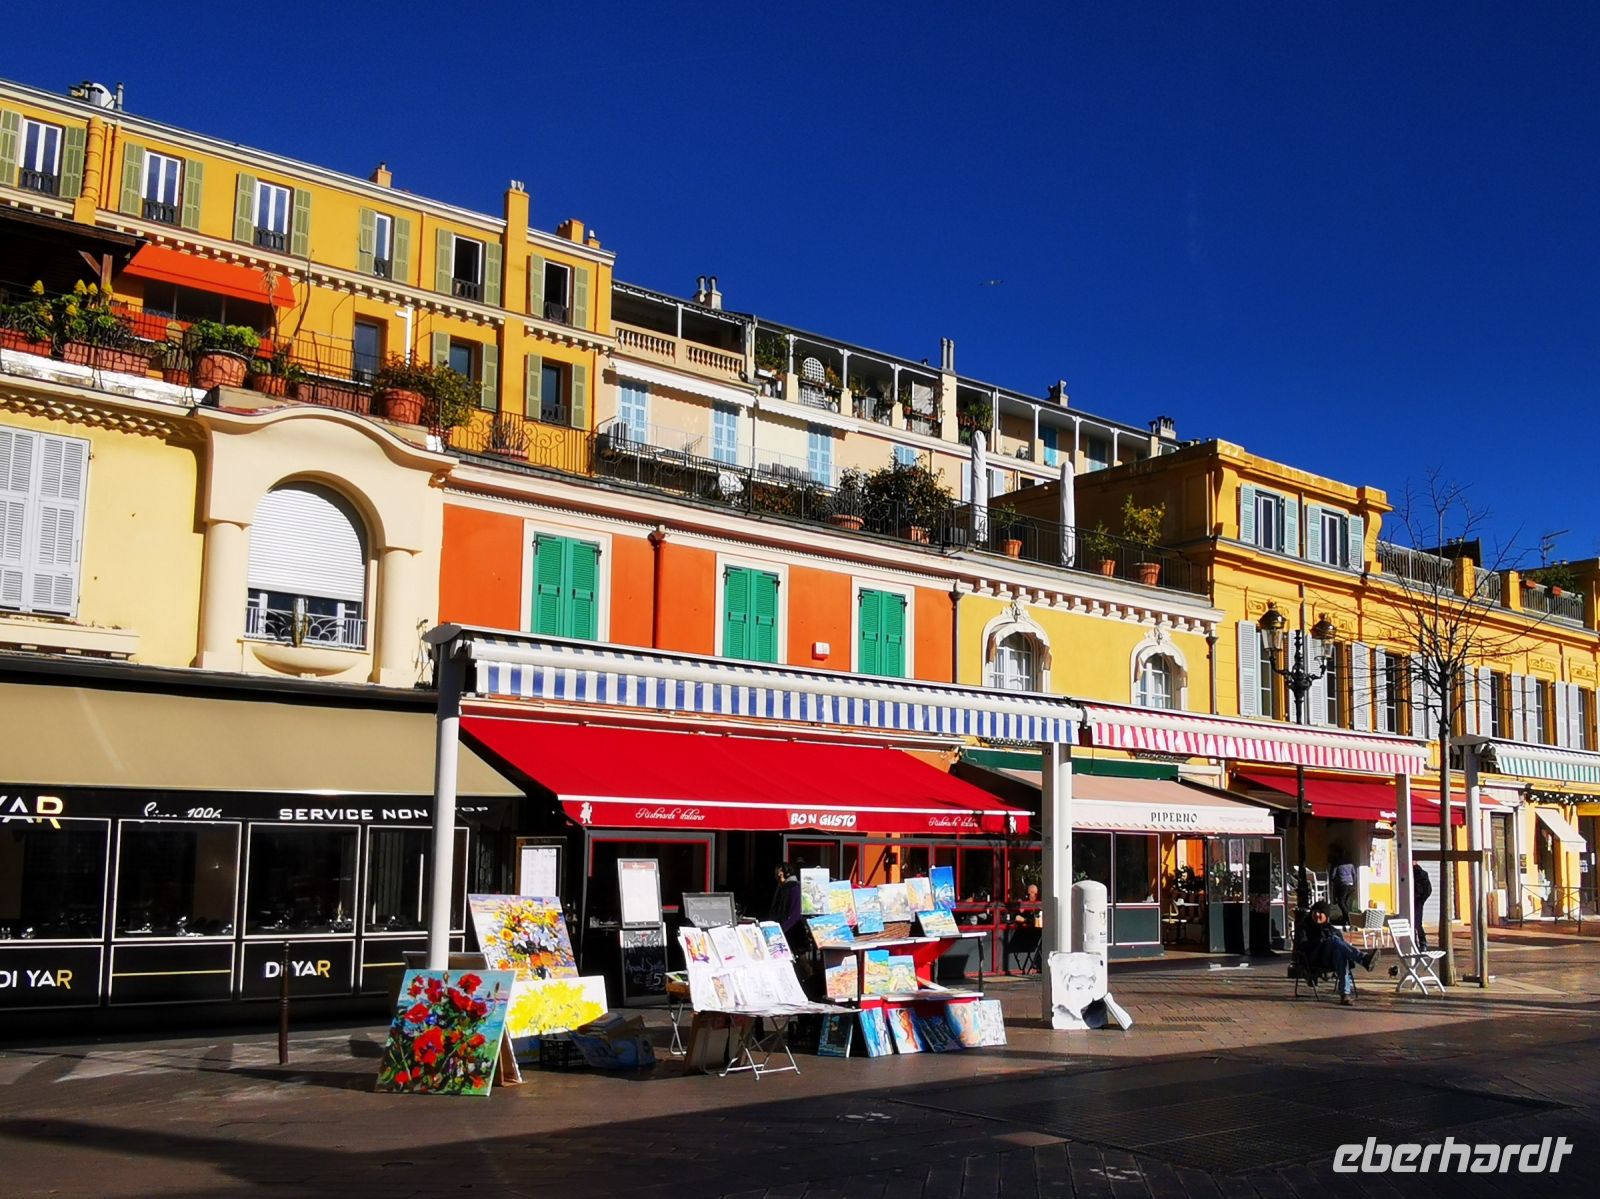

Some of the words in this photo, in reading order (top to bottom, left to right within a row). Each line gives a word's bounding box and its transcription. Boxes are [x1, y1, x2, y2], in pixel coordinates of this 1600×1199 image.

[279, 808, 374, 821] SERVICE
[382, 808, 429, 820] NON
[790, 812, 817, 825] BON
[819, 813, 857, 828] GUSTO
[1150, 812, 1198, 824] PIPERNO
[291, 959, 332, 979] YAR
[26, 969, 73, 990] YAR
